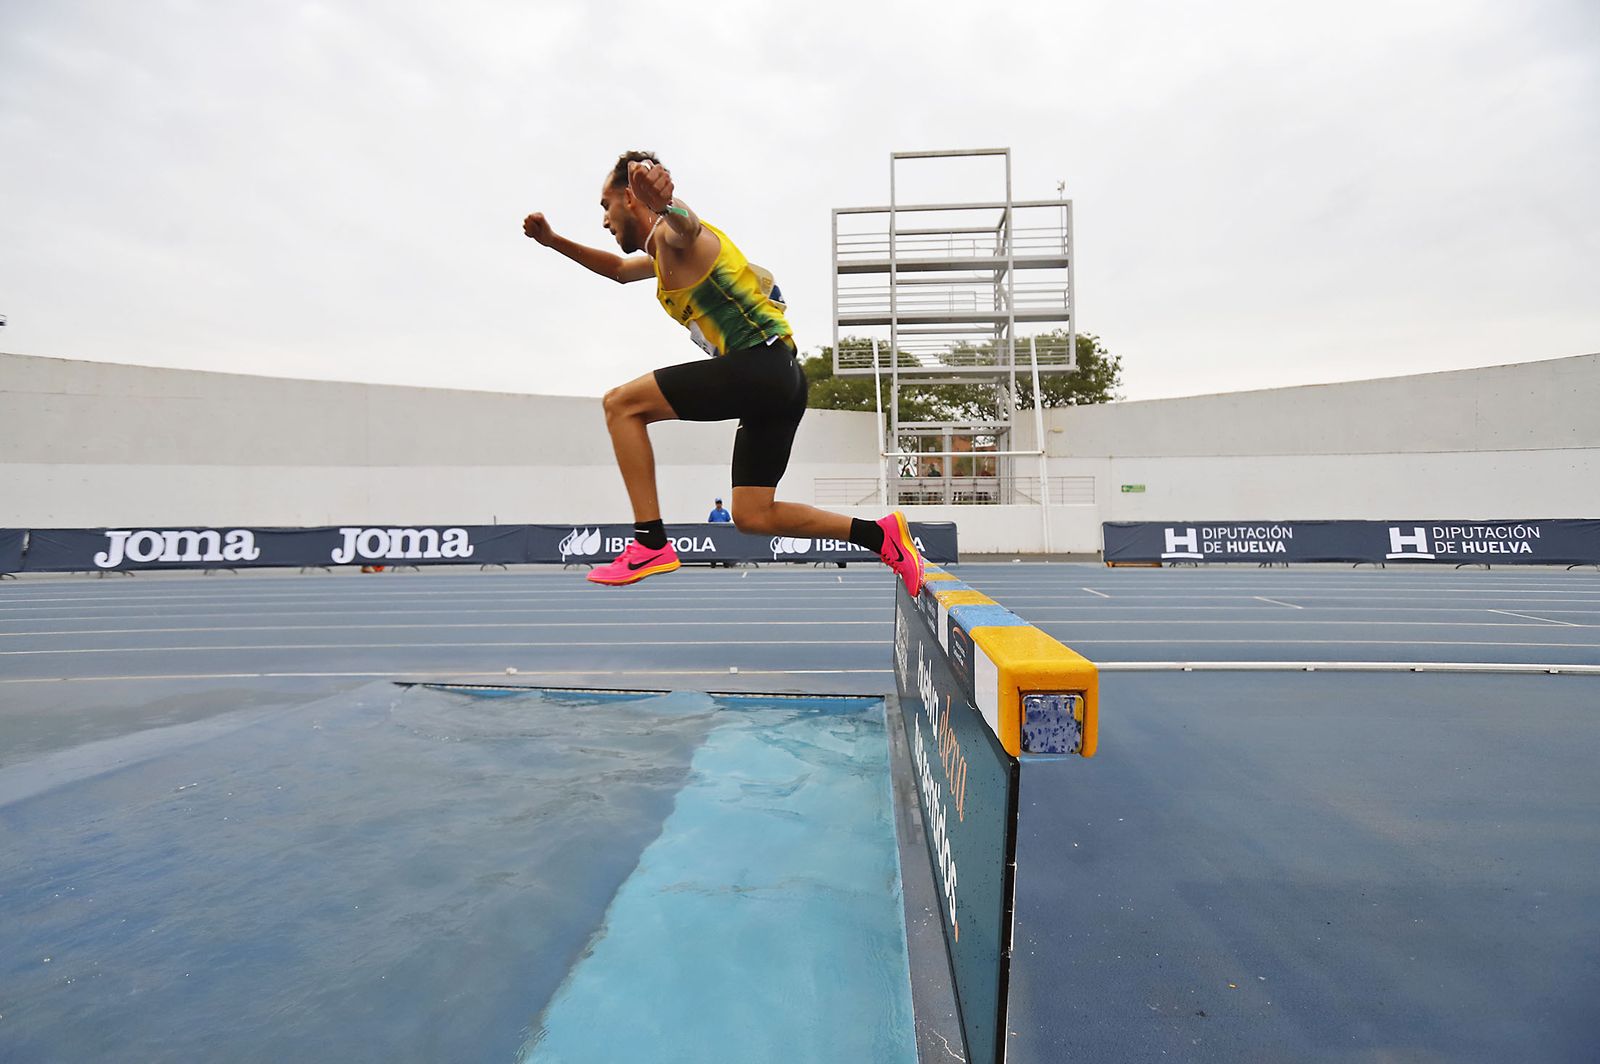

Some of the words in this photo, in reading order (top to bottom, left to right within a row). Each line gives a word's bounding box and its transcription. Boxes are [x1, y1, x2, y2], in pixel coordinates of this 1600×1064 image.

[1202, 525, 1293, 539] DIPUTACIÓN
[1432, 525, 1541, 539] DIPUTACIÓN
[1204, 541, 1223, 553] DE
[1226, 541, 1287, 553] HUELVA
[1434, 541, 1458, 554] DE
[1462, 541, 1533, 554] HUELVA
